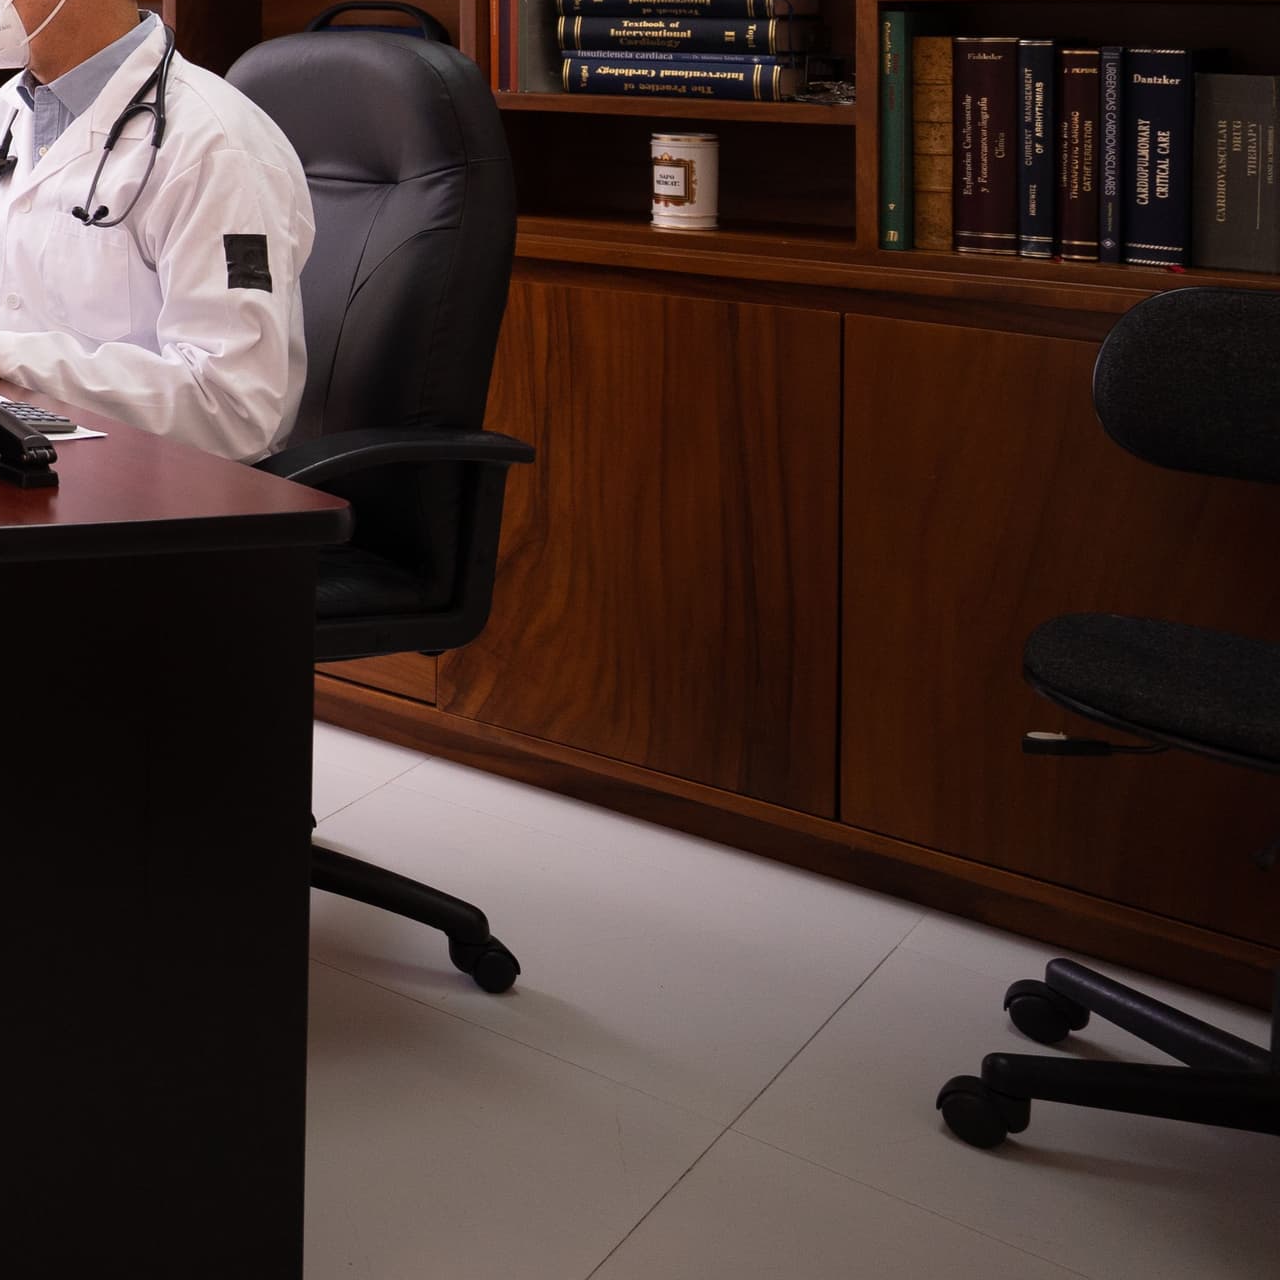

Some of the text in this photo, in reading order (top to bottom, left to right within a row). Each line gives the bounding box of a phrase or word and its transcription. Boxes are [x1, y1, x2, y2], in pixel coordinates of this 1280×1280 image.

[609, 28, 692, 38] Interventional
[621, 20, 680, 29] Textbook of
[577, 50, 634, 59] Insuficiencia
[635, 51, 673, 60] cardiaca
[595, 66, 744, 81] Interventional Cardiology
[1133, 74, 1182, 86] Dantzker
[624, 82, 714, 94] The Practice of
[962, 94, 973, 149] Cardiovascular
[1024, 67, 1033, 167] CURRENT MANAGEMENT
[1035, 81, 1044, 155] OF ARRHYTHMIAS
[1104, 62, 1117, 197] URGENCIAS CARDIOVASCULARES
[1232, 120, 1242, 152] DRUG
[1069, 111, 1080, 200] THERAPEUTIC CARDIAC
[1082, 120, 1093, 192] CATHETERIZATION
[1136, 118, 1151, 205] CARDIOPULMONARY
[1155, 130, 1170, 199] CRITICAL CARE
[1216, 120, 1228, 222] CARDIOVASCULAR
[1247, 121, 1257, 176] THERAPY
